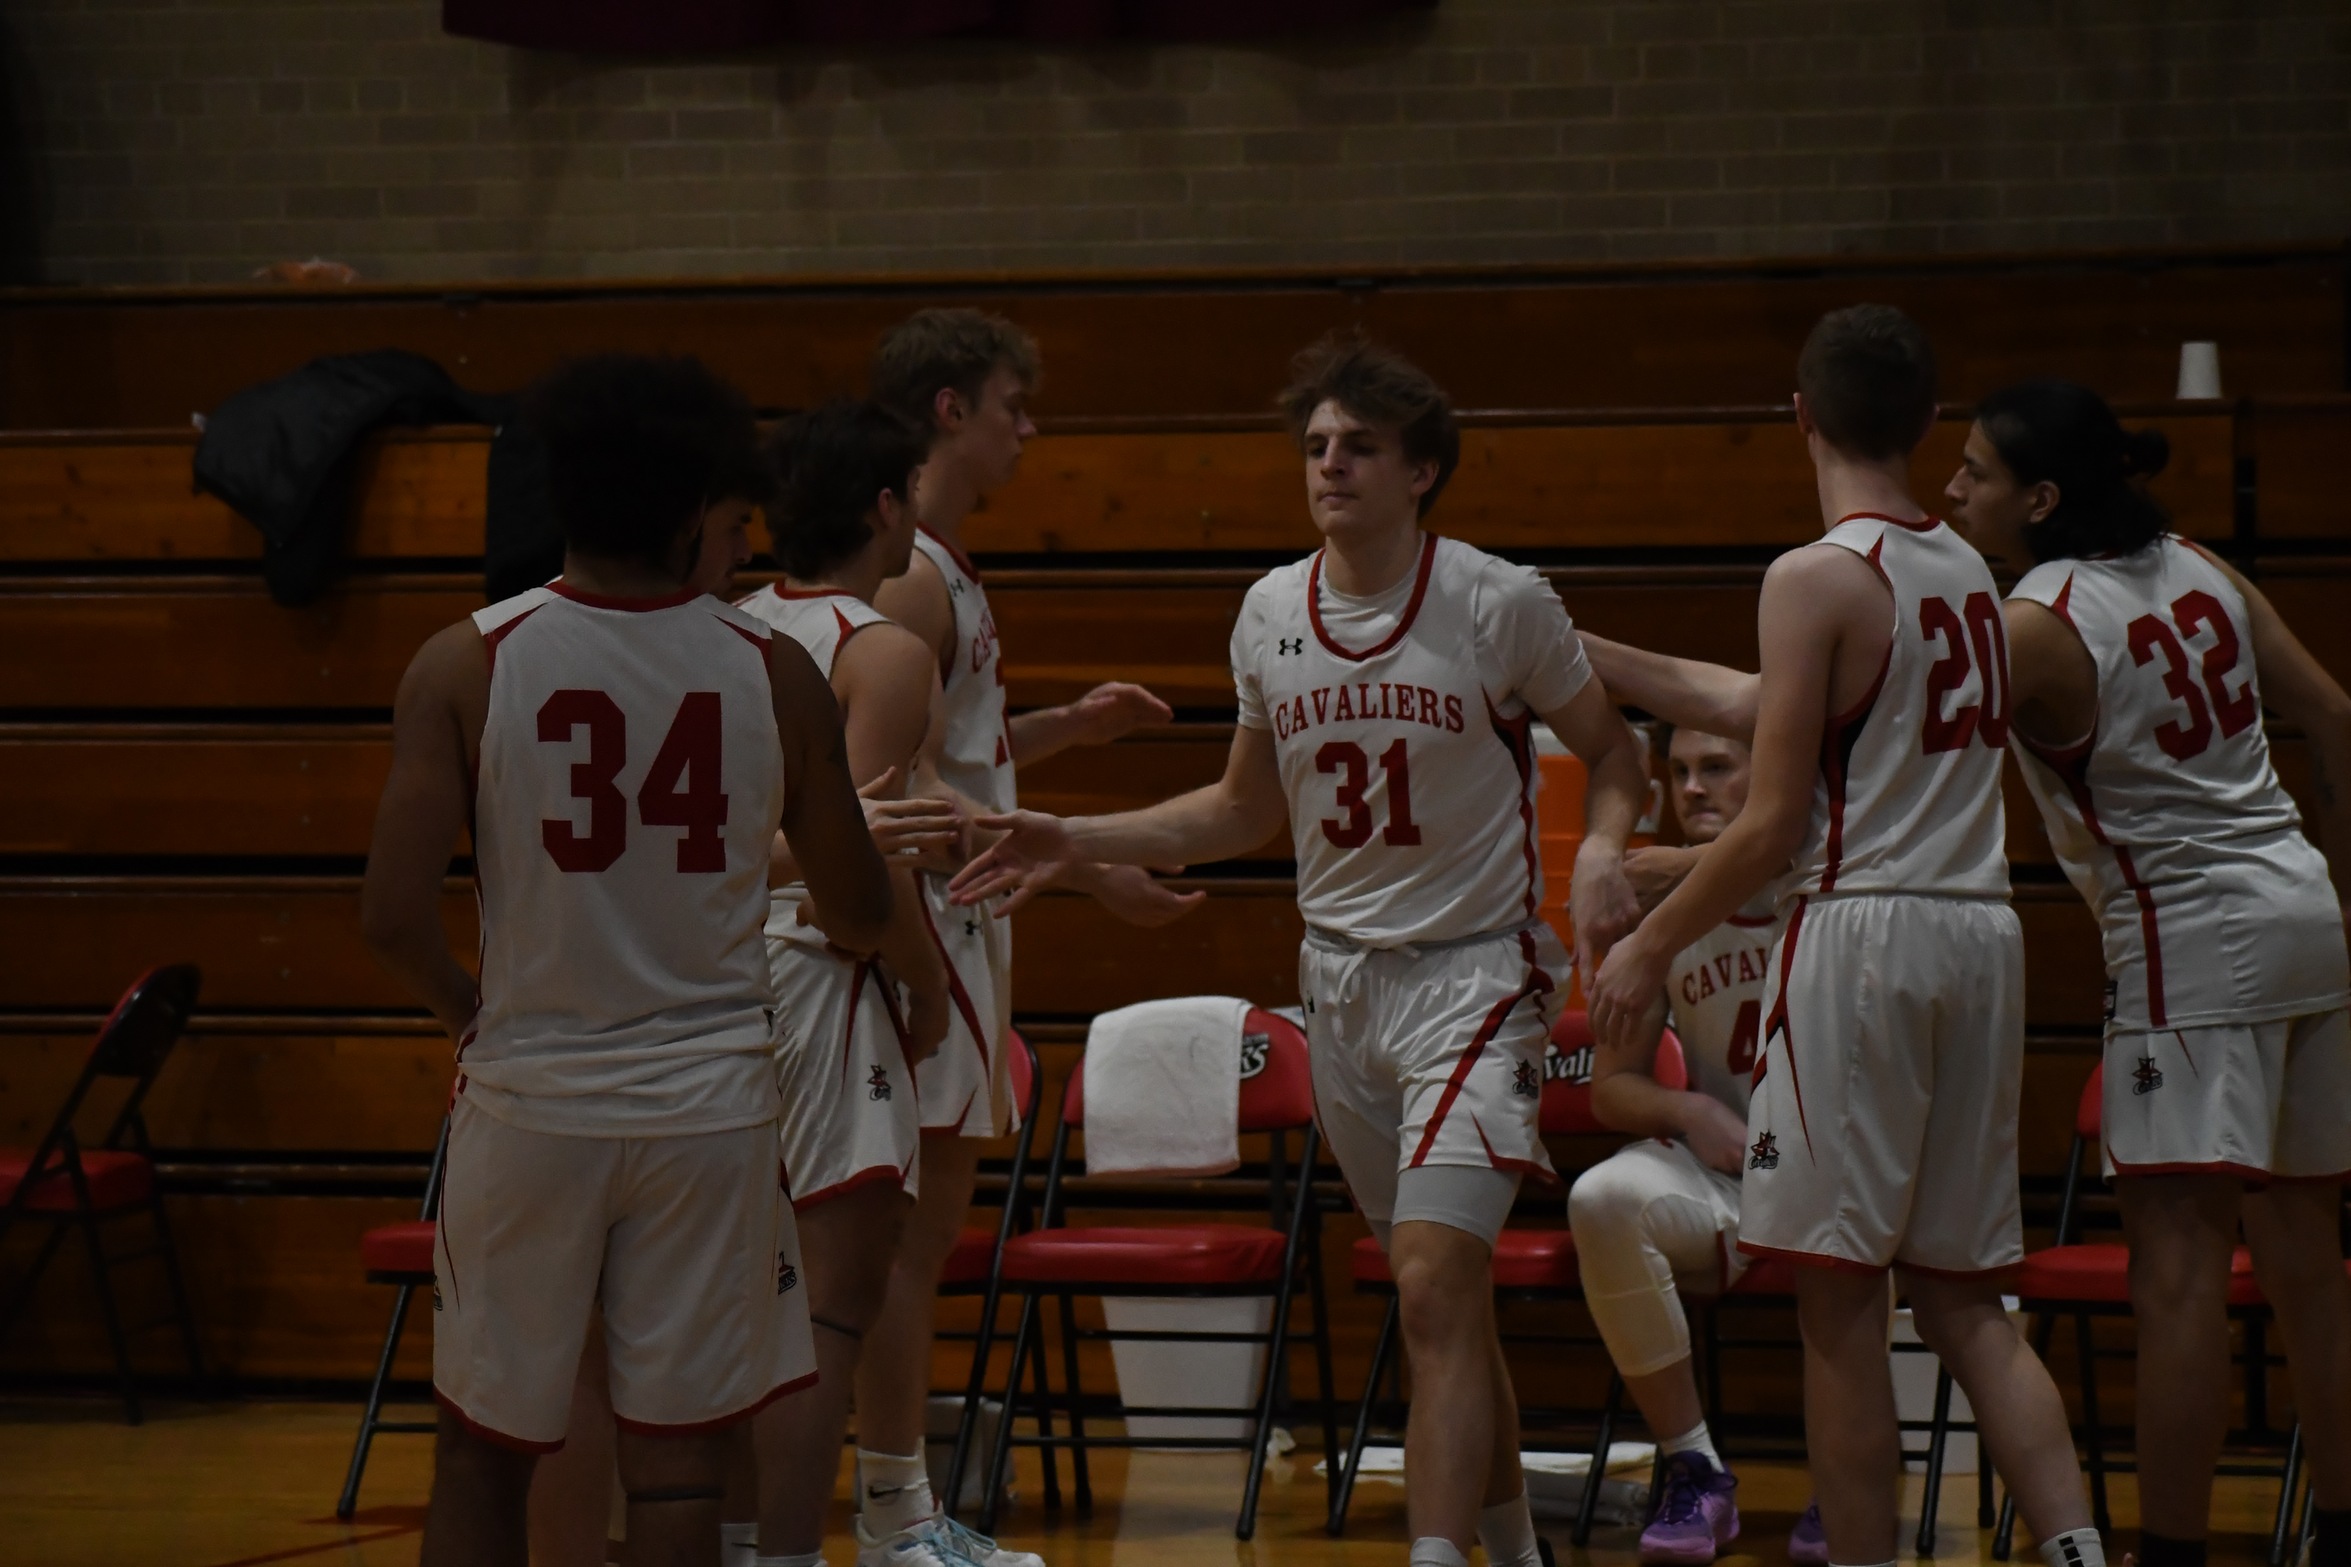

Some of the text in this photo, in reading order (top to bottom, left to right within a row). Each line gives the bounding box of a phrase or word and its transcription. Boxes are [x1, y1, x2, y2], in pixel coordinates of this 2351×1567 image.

[1276, 683, 1465, 740] CAVALIERS
[1919, 591, 2010, 756] 20
[2127, 589, 2256, 762] 32
[536, 689, 729, 873] 34
[1315, 738, 1422, 848] 31
